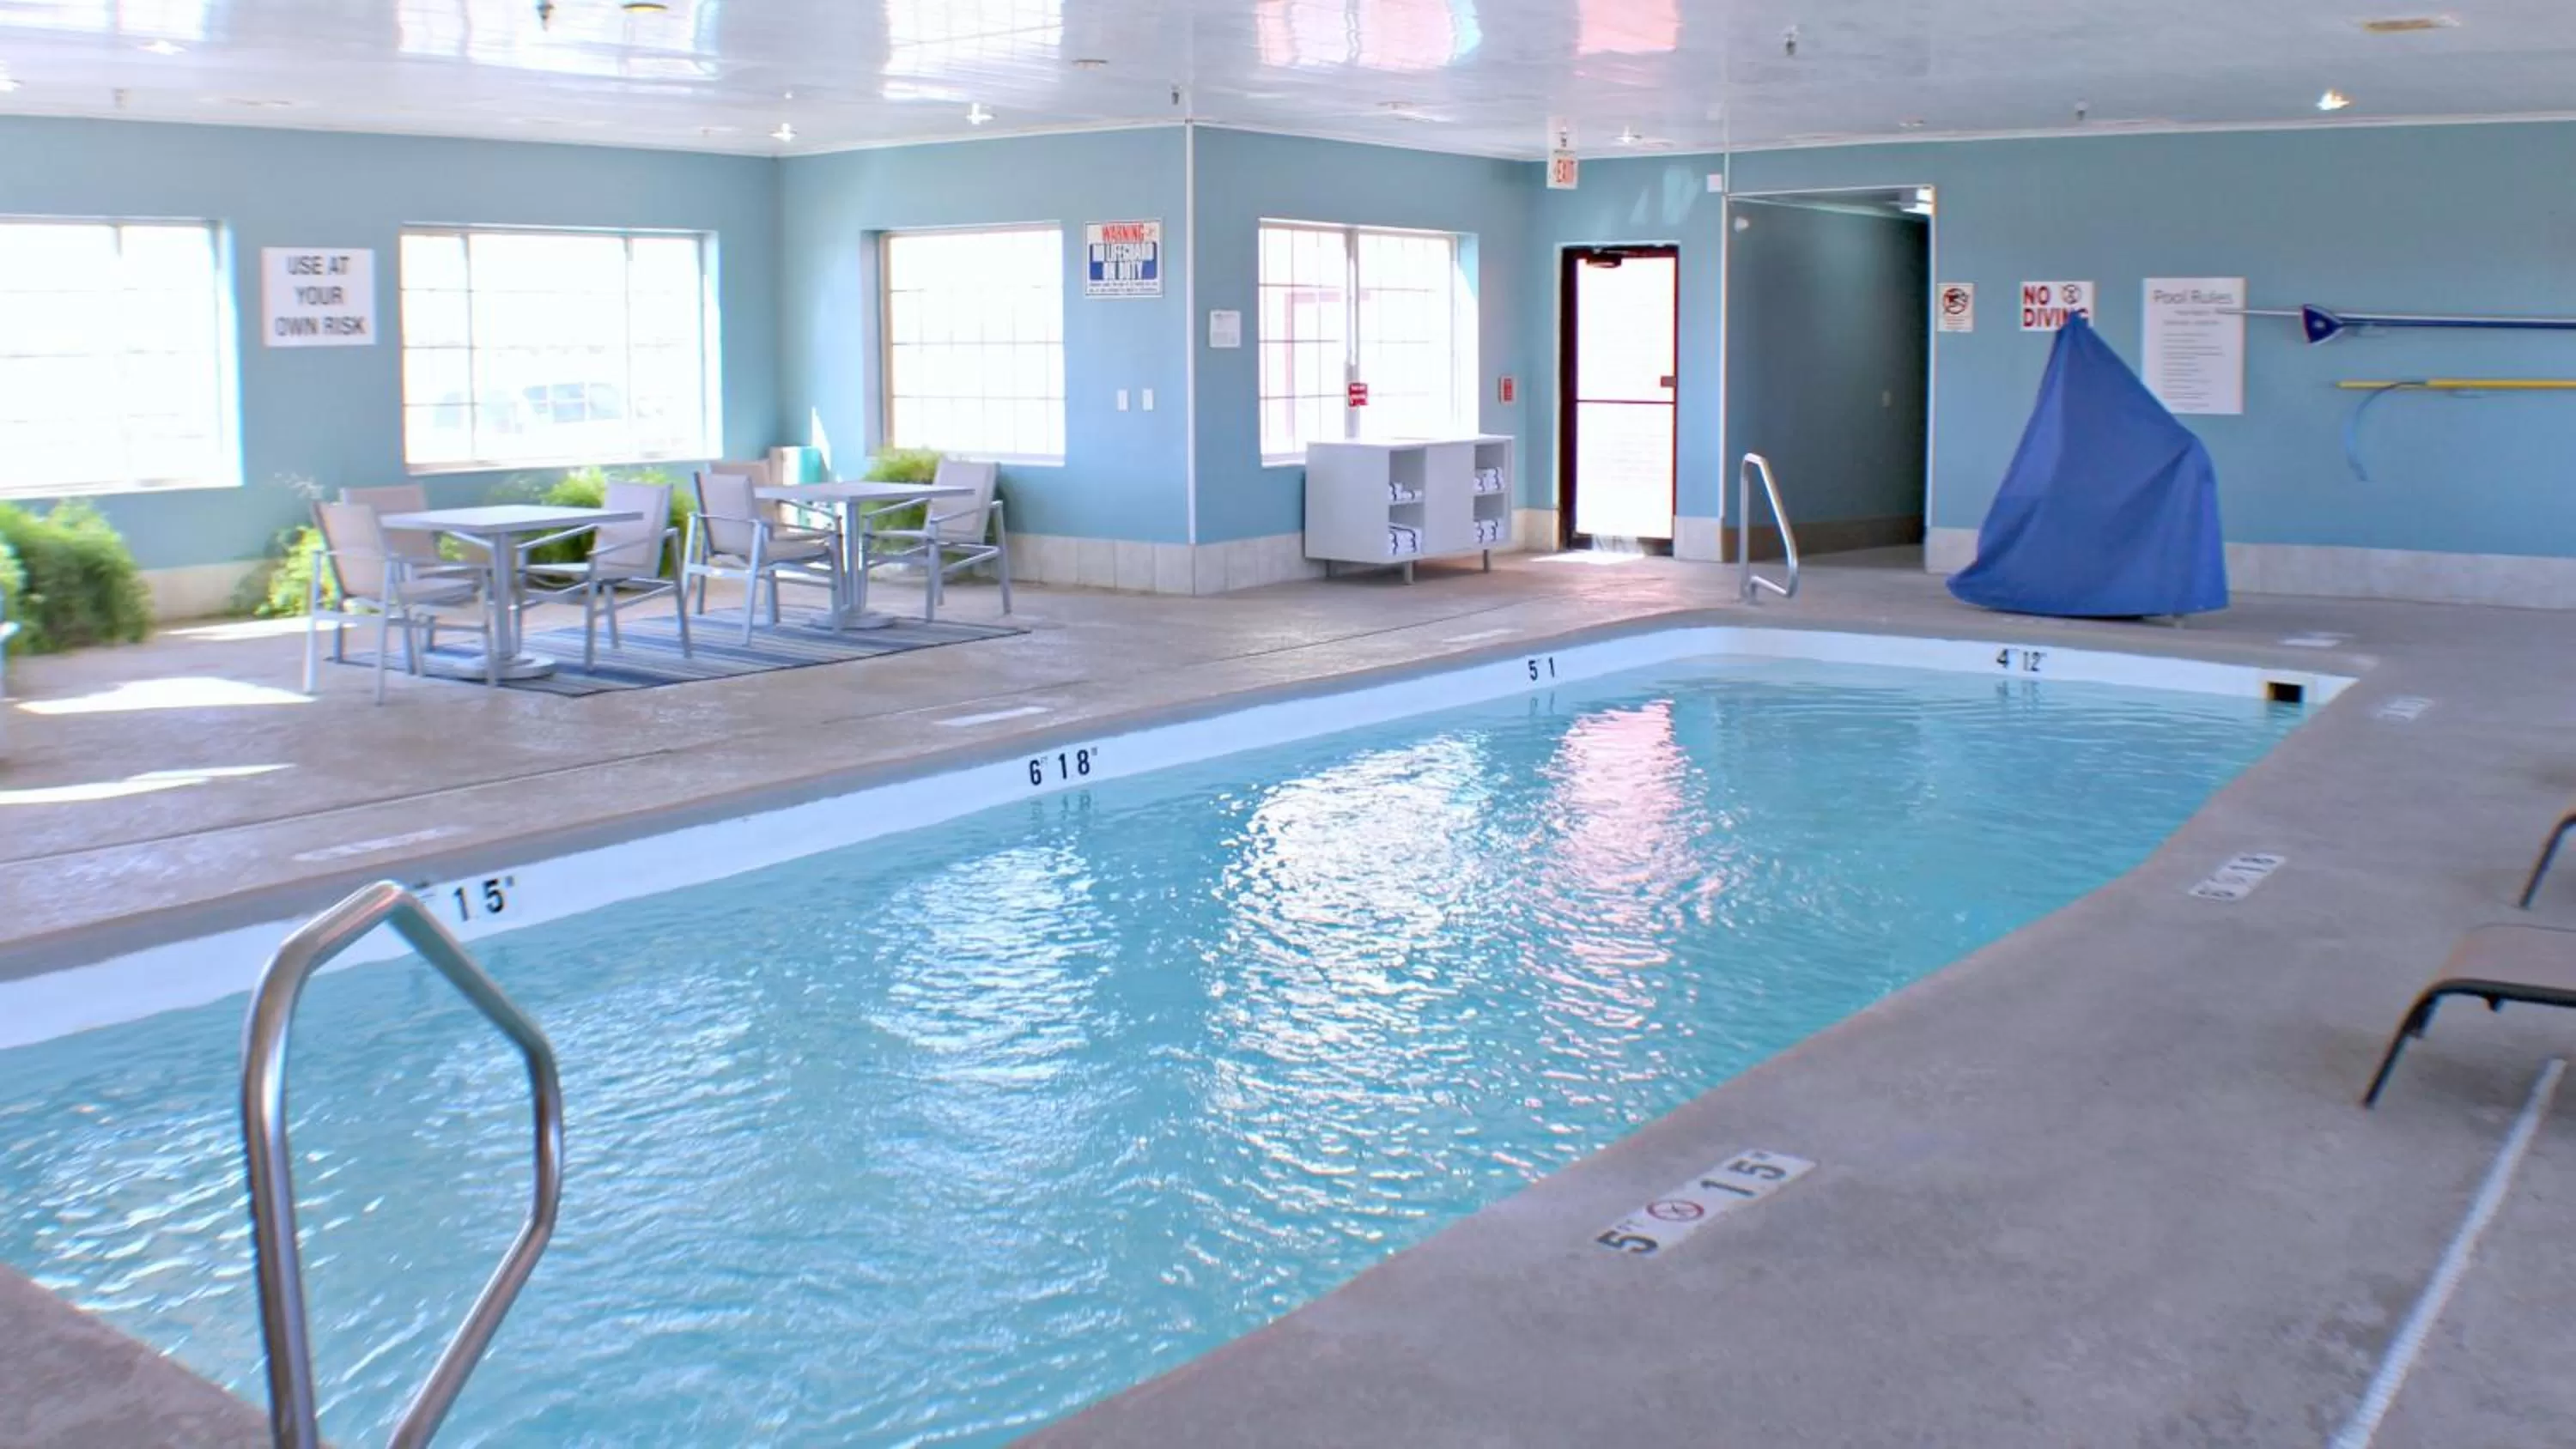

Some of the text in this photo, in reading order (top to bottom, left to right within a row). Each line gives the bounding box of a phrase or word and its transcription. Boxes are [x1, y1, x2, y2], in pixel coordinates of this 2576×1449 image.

[288, 255, 350, 275] USE AT
[295, 286, 345, 305] YOUR
[2023, 285, 2050, 305] NO
[2153, 288, 2233, 304] Pool Rules
[274, 316, 367, 336] OWN RISK
